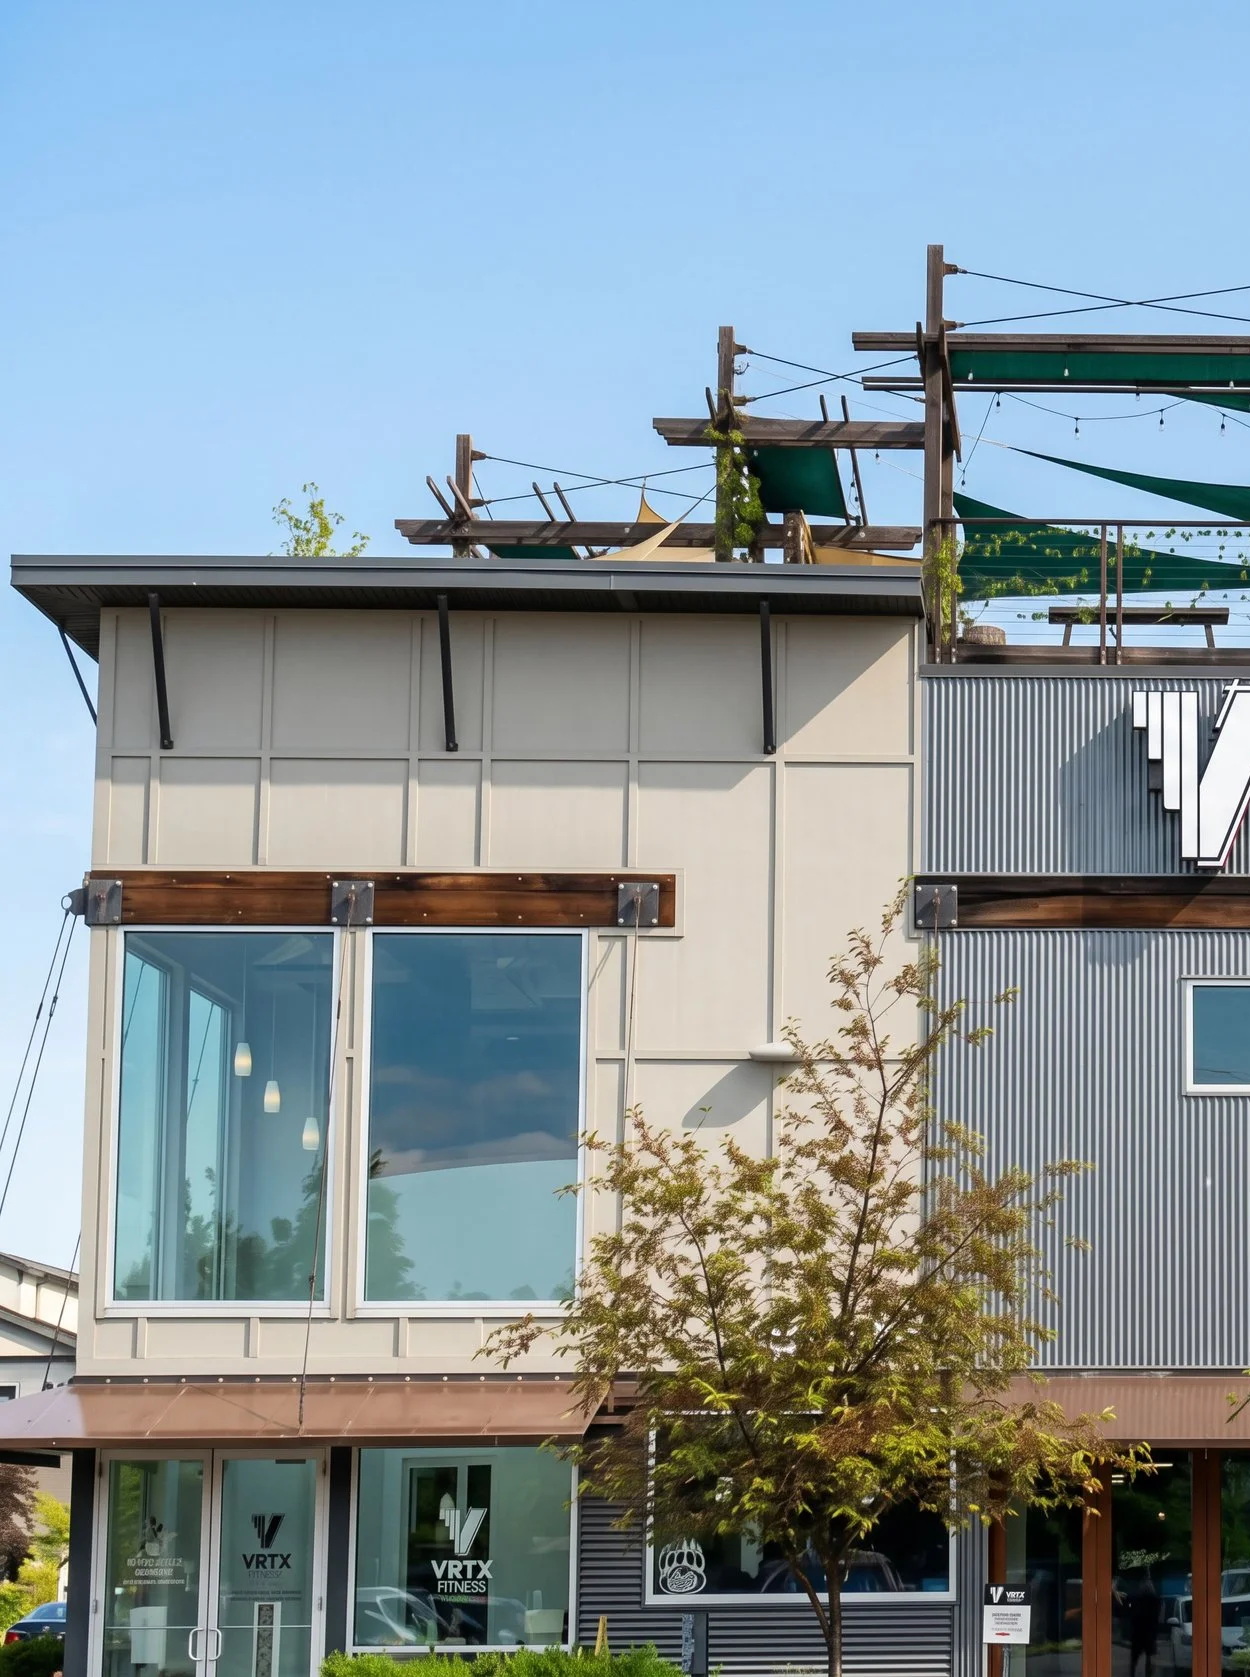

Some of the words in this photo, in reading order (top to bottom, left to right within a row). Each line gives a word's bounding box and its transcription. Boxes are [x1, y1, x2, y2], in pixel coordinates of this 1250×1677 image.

[242, 1553, 292, 1570] VRTX
[431, 1559, 493, 1579] VRTX
[437, 1581, 487, 1593] FITNESS
[1005, 1591, 1025, 1599] VRTX
